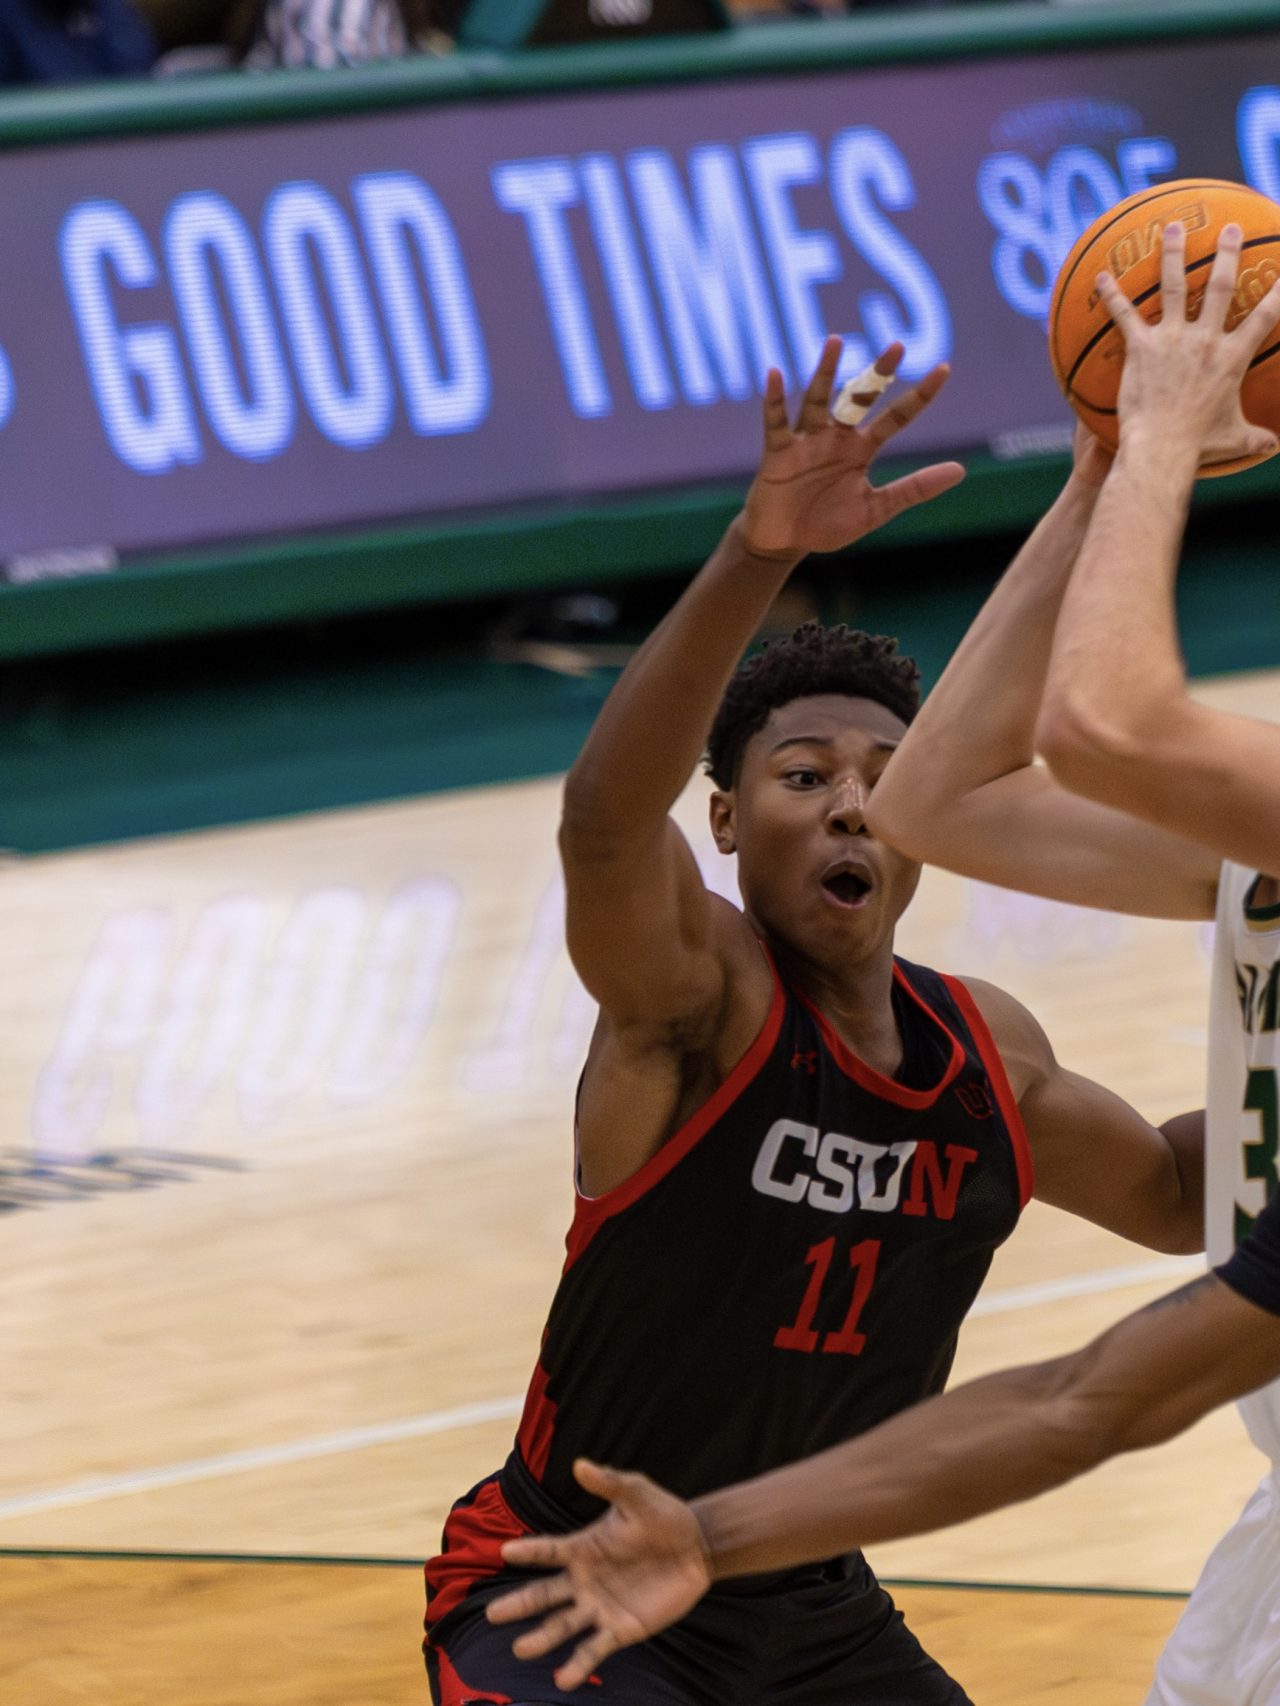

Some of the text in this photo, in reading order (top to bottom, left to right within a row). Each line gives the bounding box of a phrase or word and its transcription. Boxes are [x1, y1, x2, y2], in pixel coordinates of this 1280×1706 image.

[58, 125, 954, 475] GOOD TIMES
[751, 1118, 979, 1221] CSUN
[1234, 1066, 1280, 1252] 3
[773, 1235, 881, 1356] 11
